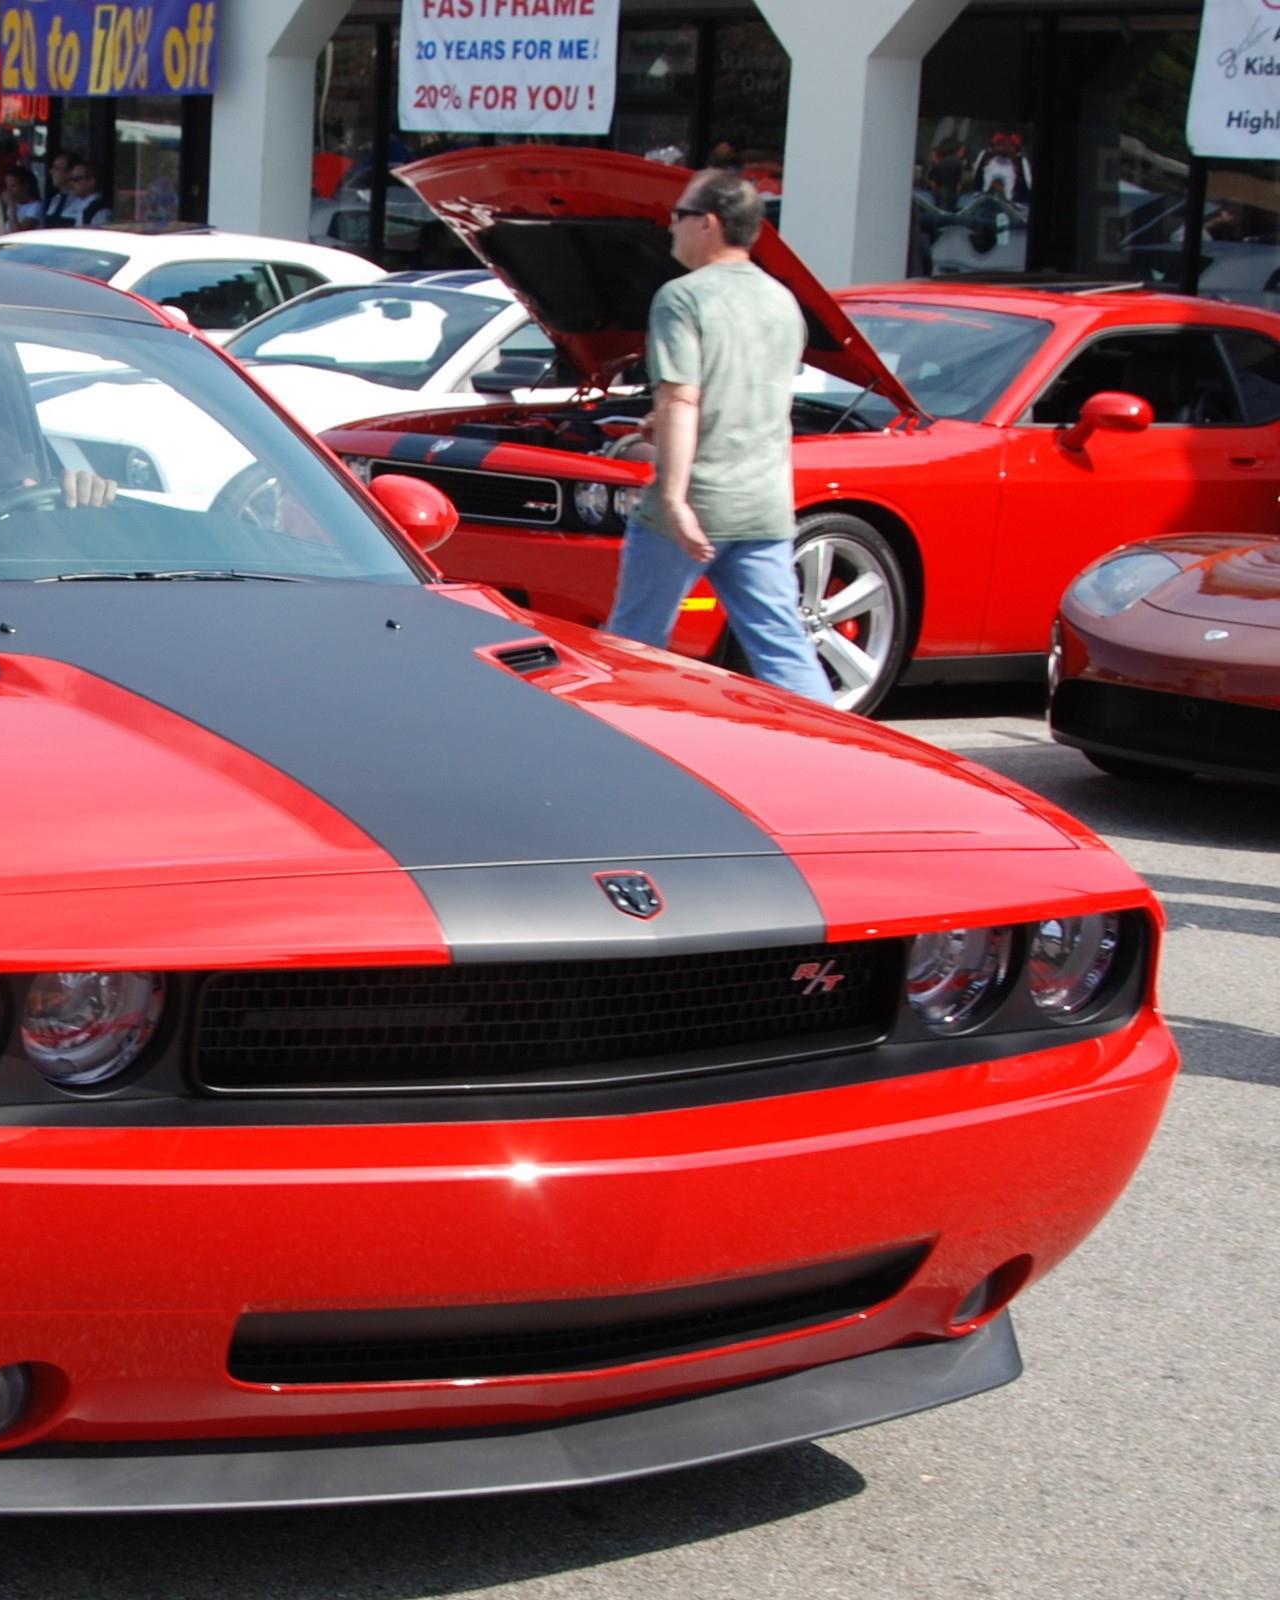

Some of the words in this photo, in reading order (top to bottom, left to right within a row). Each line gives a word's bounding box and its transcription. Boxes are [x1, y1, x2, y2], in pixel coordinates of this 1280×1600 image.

[422, 0, 595, 18] FASTFRAME
[2, 8, 37, 90] 20
[47, 15, 80, 90] to
[163, 2, 215, 90] off
[443, 40, 506, 60] YEARS
[512, 40, 552, 60] FOR
[413, 84, 462, 110] 20%
[469, 85, 518, 110] FOR
